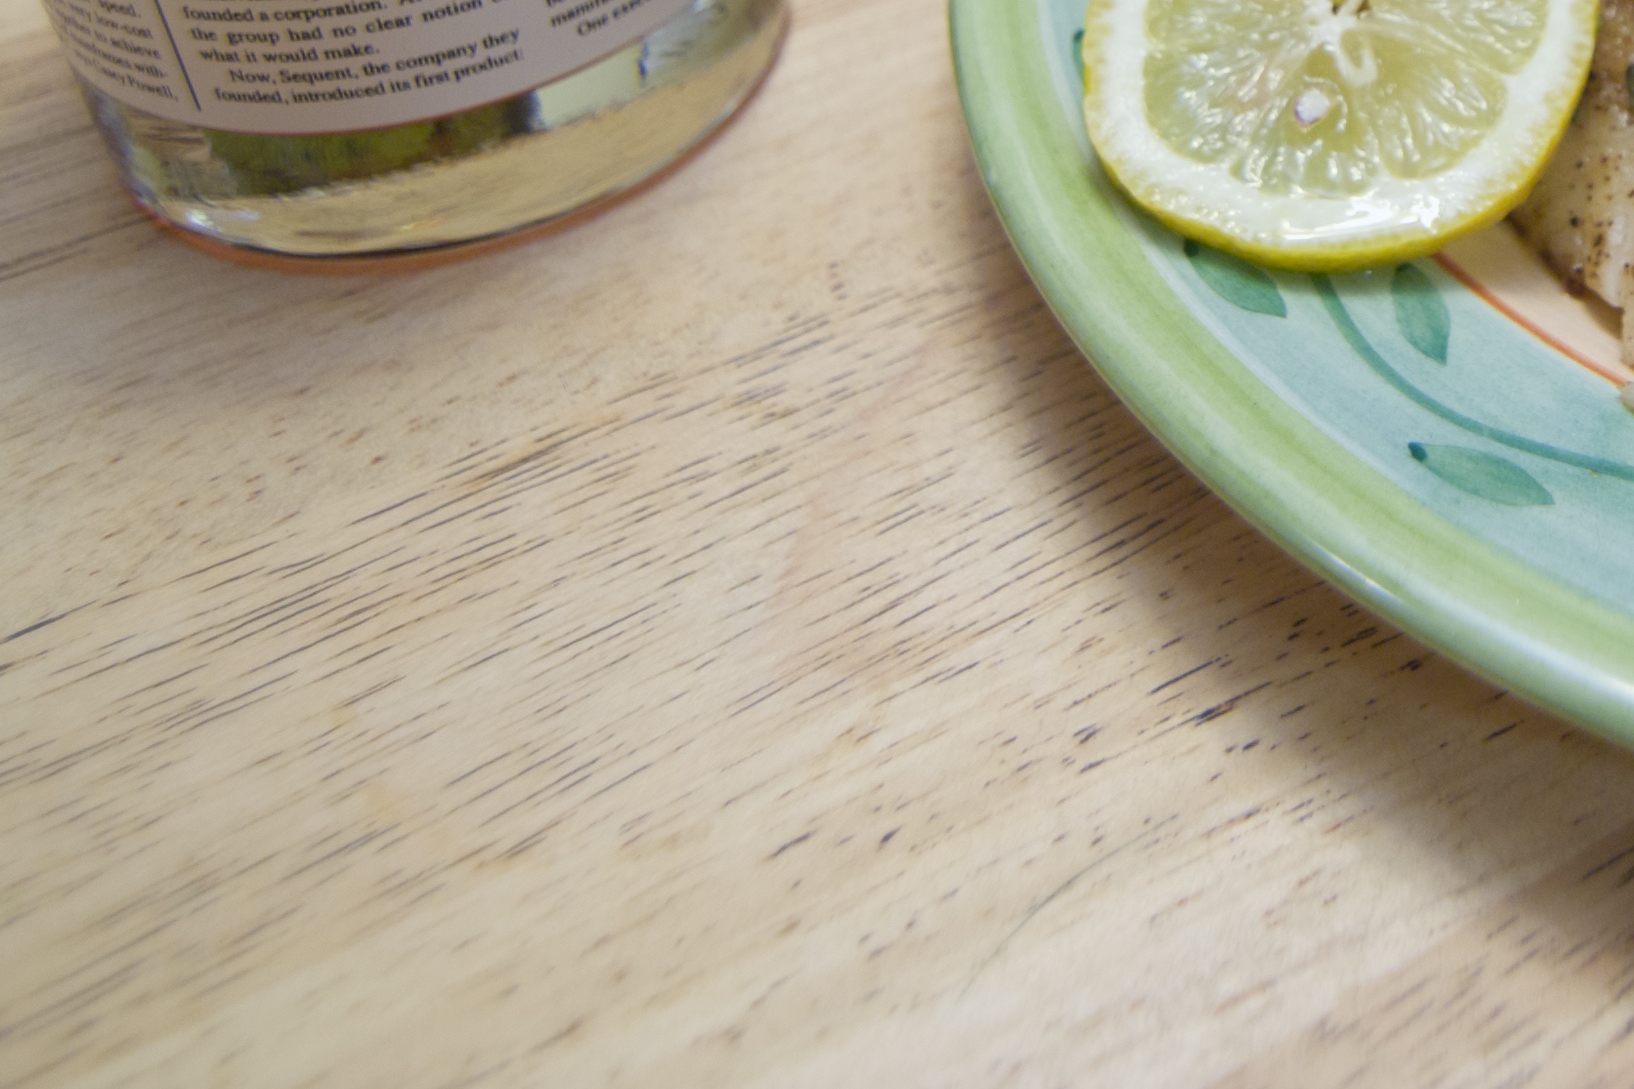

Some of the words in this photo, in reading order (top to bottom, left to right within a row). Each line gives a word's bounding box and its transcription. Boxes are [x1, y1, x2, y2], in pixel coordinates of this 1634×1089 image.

[182, 6, 253, 21] founded
[260, 11, 269, 21] a
[274, 0, 388, 23] corporation.
[577, 13, 609, 37] One
[191, 27, 218, 42] the
[227, 30, 280, 46] group
[287, 26, 323, 41] had
[332, 25, 357, 38] no
[365, 13, 413, 34] clear
[200, 49, 241, 63] what
[245, 50, 257, 63] it
[263, 48, 318, 63] would
[323, 44, 381, 61] make.
[229, 69, 277, 85] Now,
[279, 65, 359, 86] Sequent,
[363, 59, 392, 77] the
[396, 41, 478, 72] company
[481, 28, 520, 52] they
[214, 87, 288, 104] founded,
[292, 80, 386, 104] introduced
[390, 76, 411, 93] its
[414, 70, 451, 90] first
